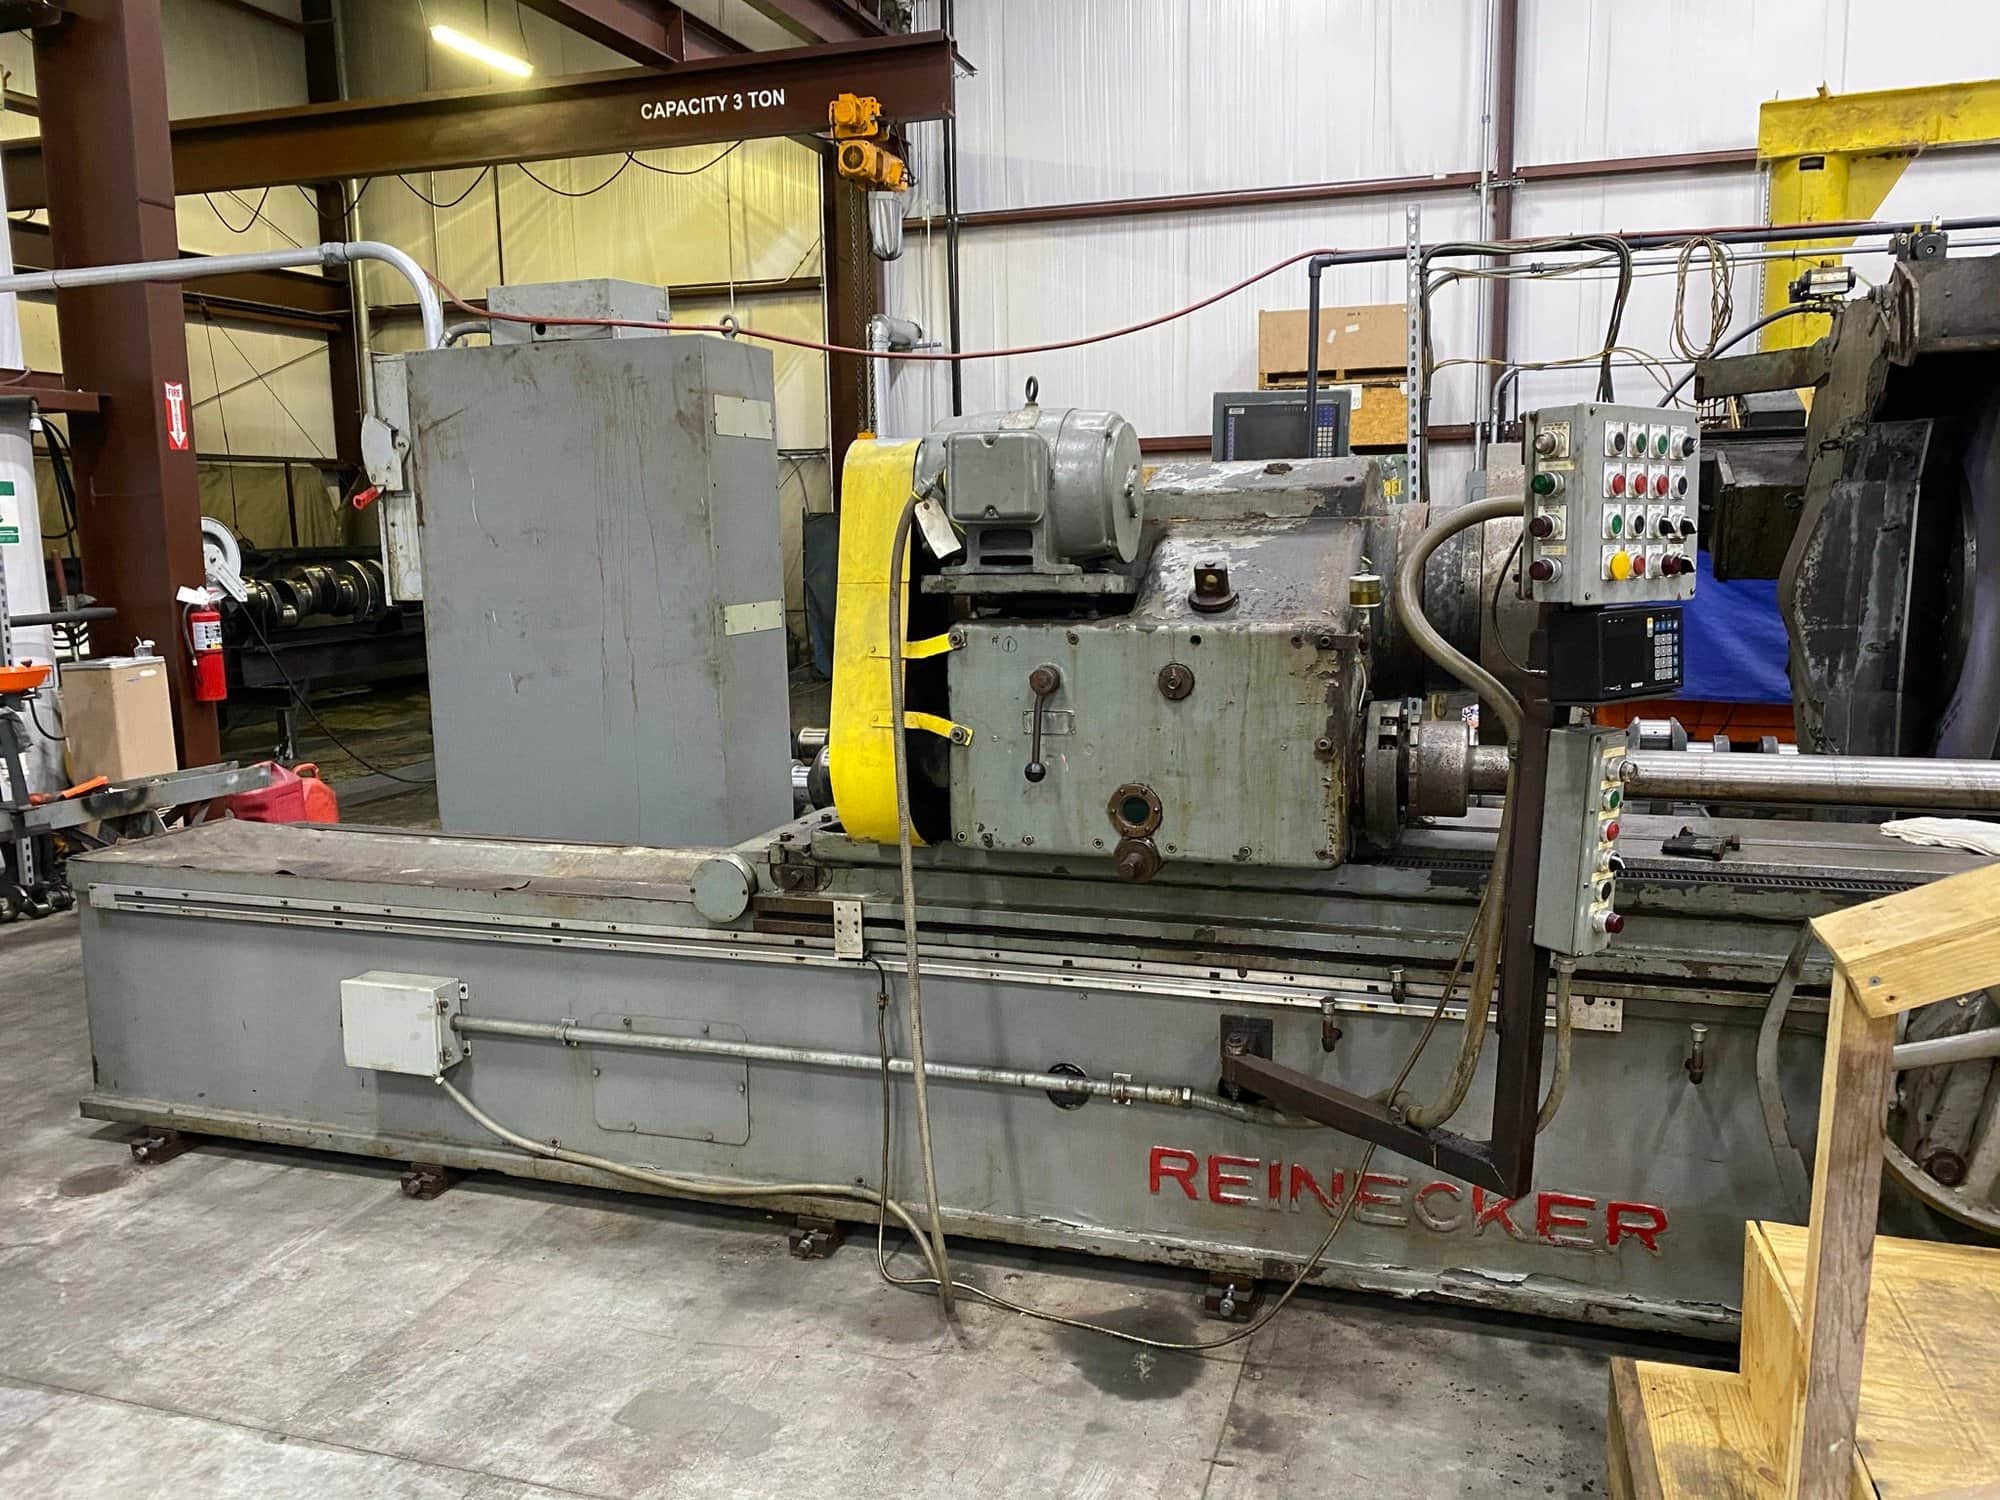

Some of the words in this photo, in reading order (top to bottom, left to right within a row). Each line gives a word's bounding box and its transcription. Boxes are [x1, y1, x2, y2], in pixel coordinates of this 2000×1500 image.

[640, 94, 728, 120] CAPACITY
[733, 93, 743, 110] 3
[747, 88, 785, 109] TON
[1149, 1145, 1669, 1256] REINECKER
